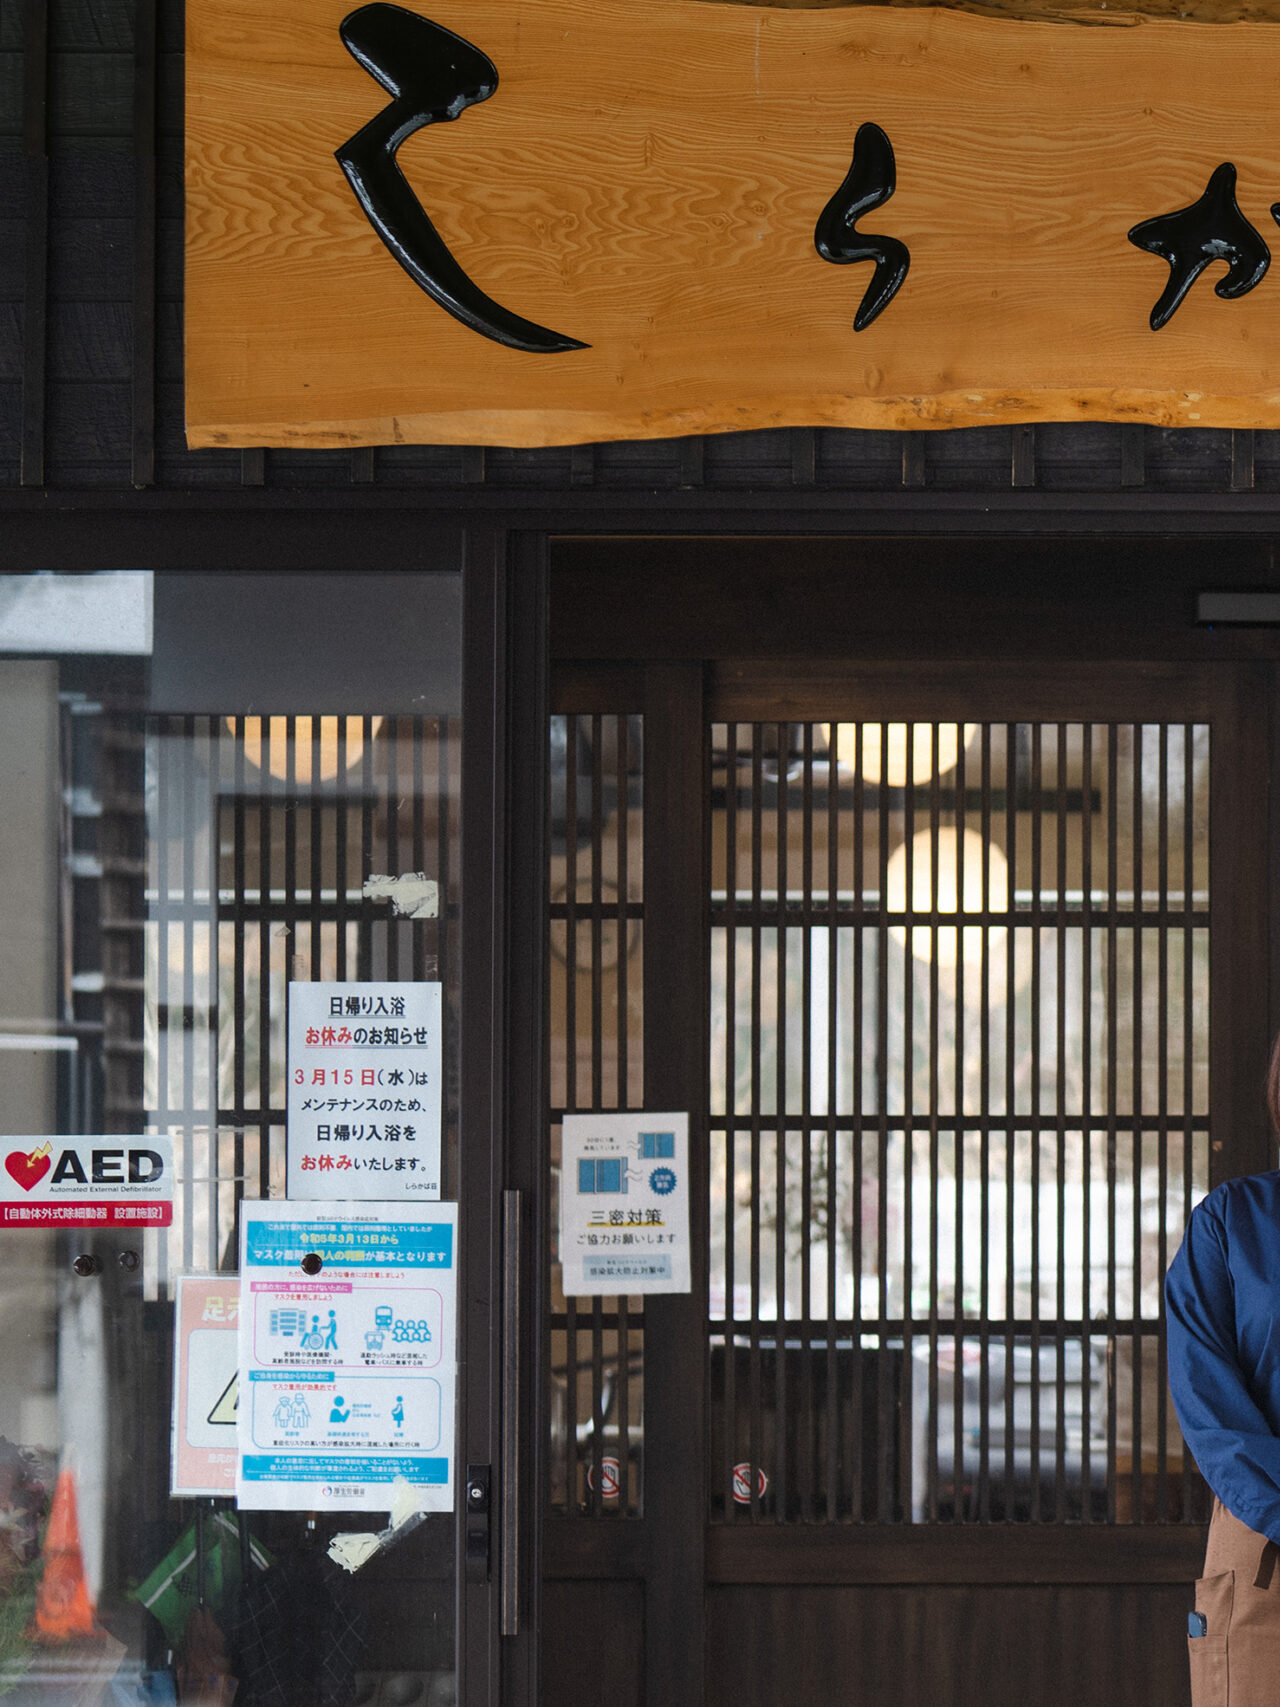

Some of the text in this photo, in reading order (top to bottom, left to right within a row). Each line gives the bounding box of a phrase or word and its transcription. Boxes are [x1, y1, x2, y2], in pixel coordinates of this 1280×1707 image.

[330, 996, 405, 1016] 日帰り入浴
[305, 1026, 428, 1046] お休みのお知らせ
[301, 1098, 427, 1112] メンテナンスのため、
[316, 1124, 417, 1142] 日帰り入浴を
[50, 1149, 164, 1184] AED
[300, 1154, 427, 1172] お休みいたします。
[590, 1208, 662, 1226] 三密対策
[299, 1233, 399, 1245] 令和5年3月13日から
[576, 1233, 677, 1246] ご協力お願いします
